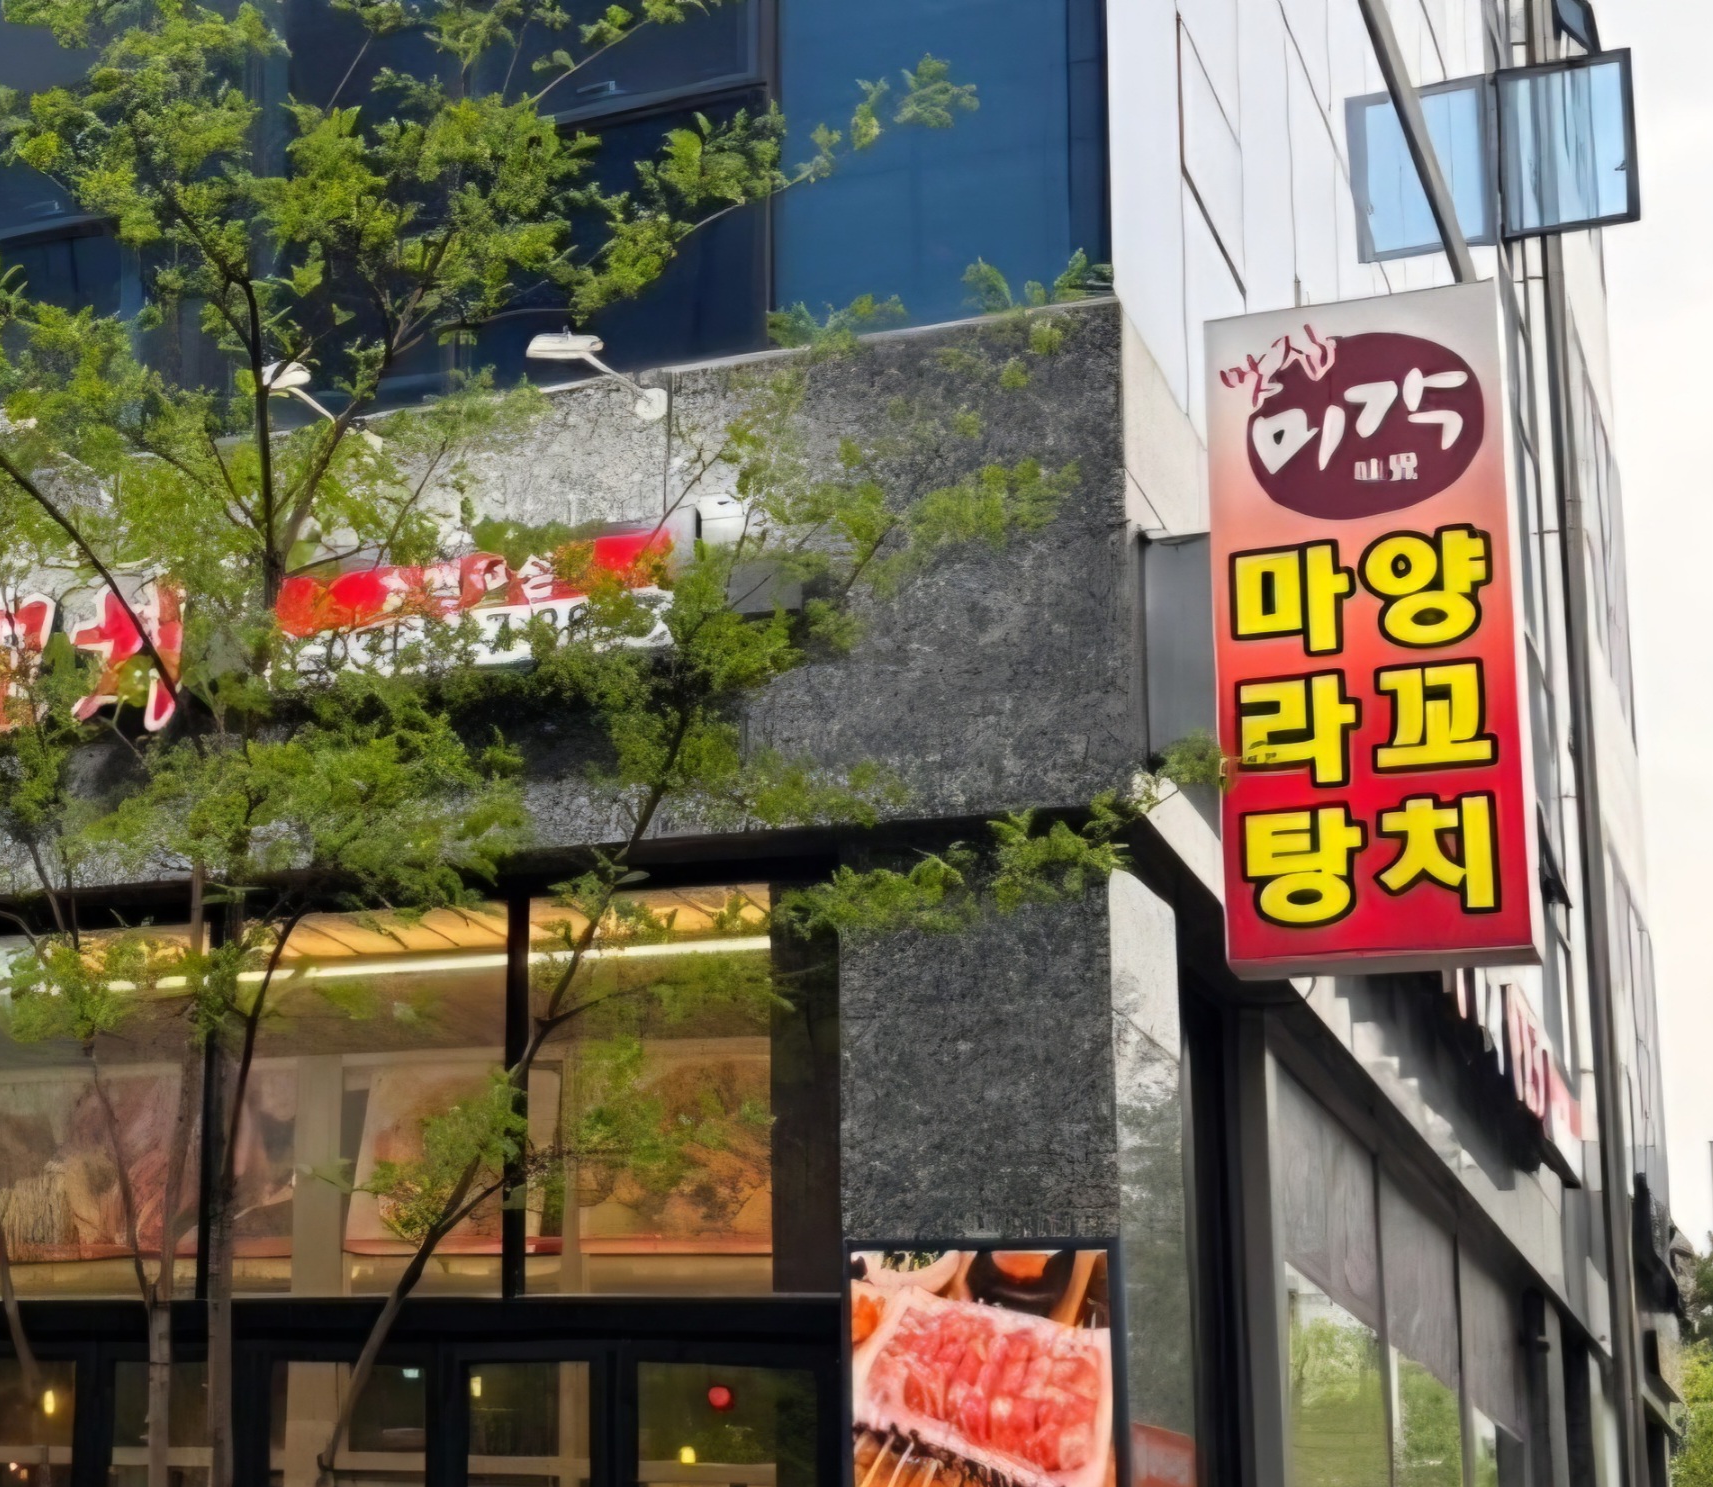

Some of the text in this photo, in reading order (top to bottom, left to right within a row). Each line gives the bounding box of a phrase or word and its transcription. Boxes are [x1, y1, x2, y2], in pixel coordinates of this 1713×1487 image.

[1251, 367, 1469, 475] 미각
[1228, 538, 1369, 928] 마라탕
[1358, 524, 1501, 914] 양꼬치
